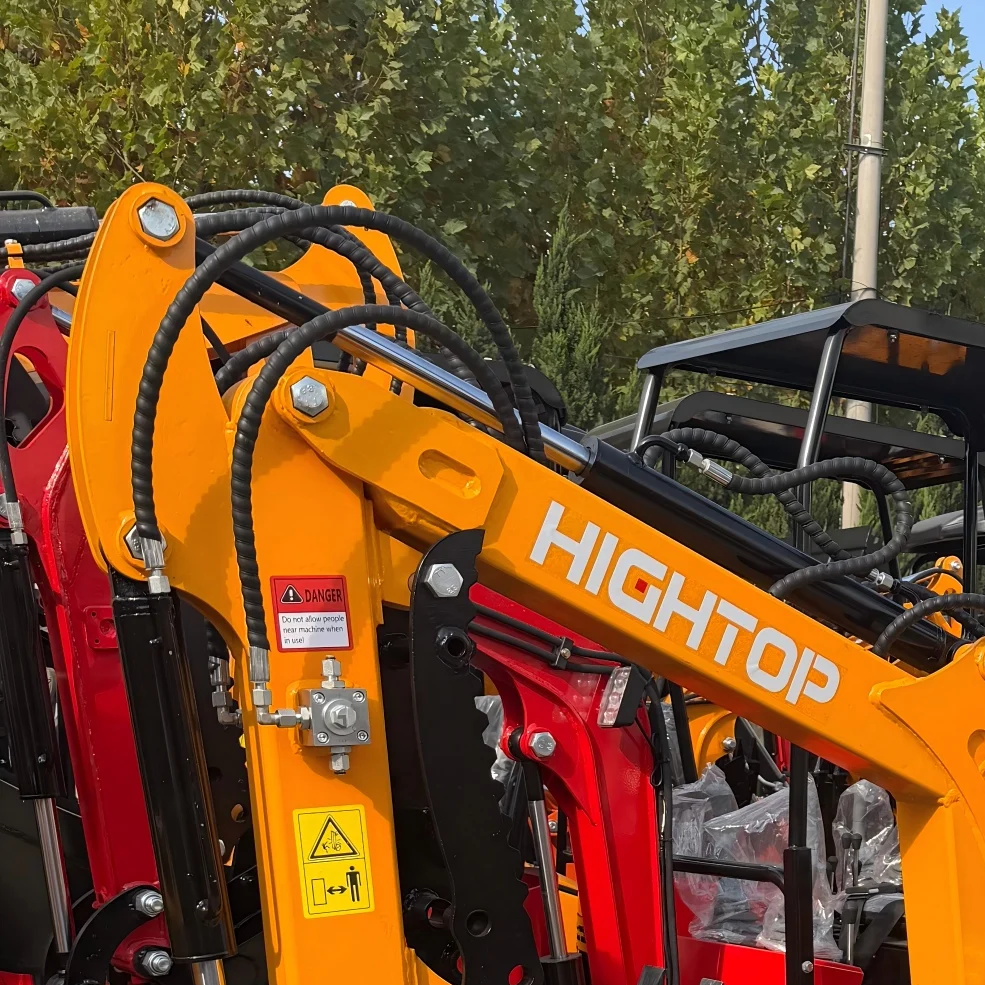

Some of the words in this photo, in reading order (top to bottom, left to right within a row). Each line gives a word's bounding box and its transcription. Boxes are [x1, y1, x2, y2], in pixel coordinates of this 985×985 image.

[304, 588, 343, 603] DANGER
[530, 500, 841, 706] HIGHTOP
[281, 615, 292, 623] Do
[293, 615, 304, 623] not
[305, 615, 322, 623] allow
[323, 614, 345, 624] people
